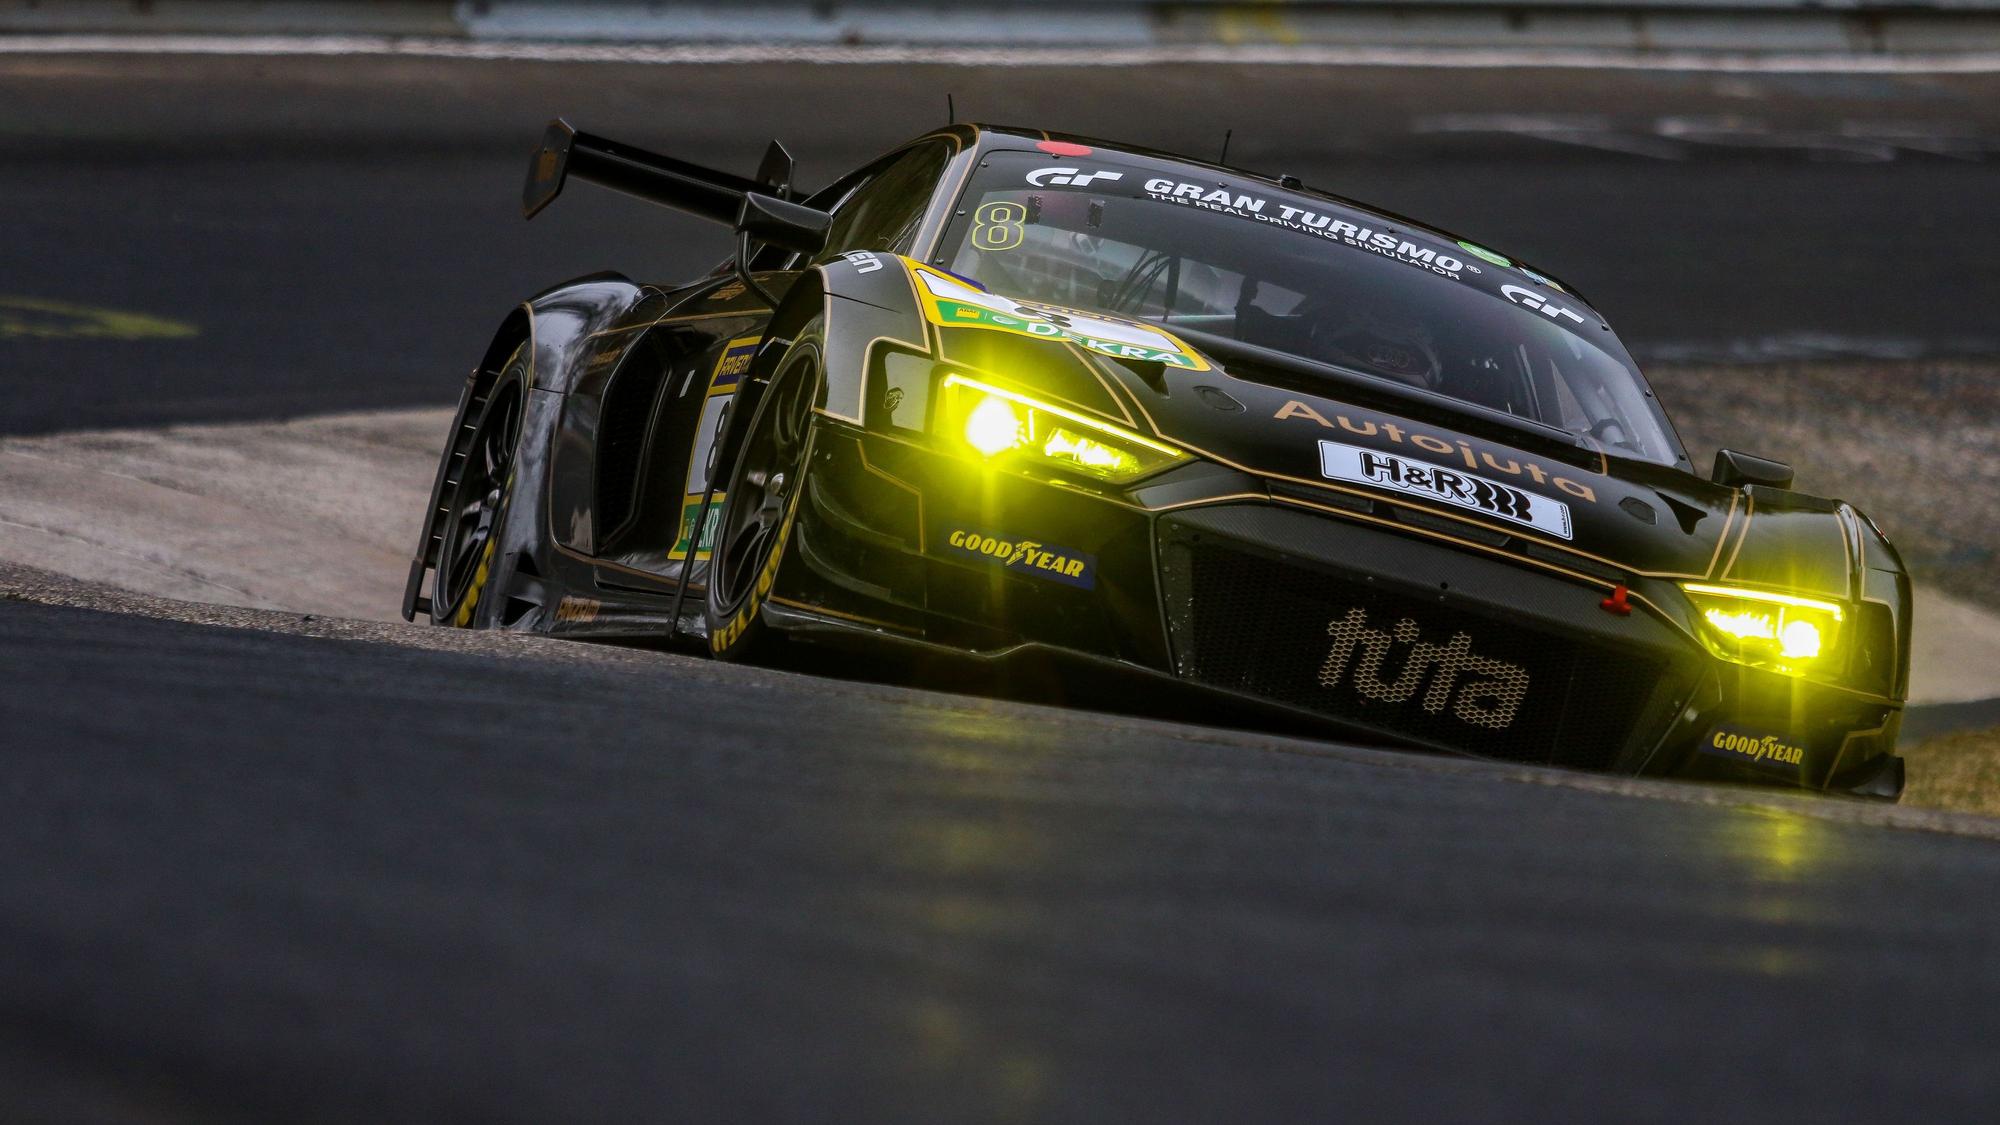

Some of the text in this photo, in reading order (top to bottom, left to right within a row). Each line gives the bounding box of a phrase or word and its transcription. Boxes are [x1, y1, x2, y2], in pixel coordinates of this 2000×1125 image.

[1144, 178, 1266, 213] GRAN
[971, 201, 1027, 251] 8
[1147, 192, 1190, 205] THE
[1195, 200, 1250, 218] REAL
[1254, 213, 1338, 241] DRIVING
[1344, 237, 1461, 281] SIMULATOR
[1027, 322, 1184, 366] DEKRA
[1273, 400, 1597, 503] Autojuta
[949, 530, 1085, 578] GOODYEAR
[1712, 731, 1804, 765] GOODYEAR
